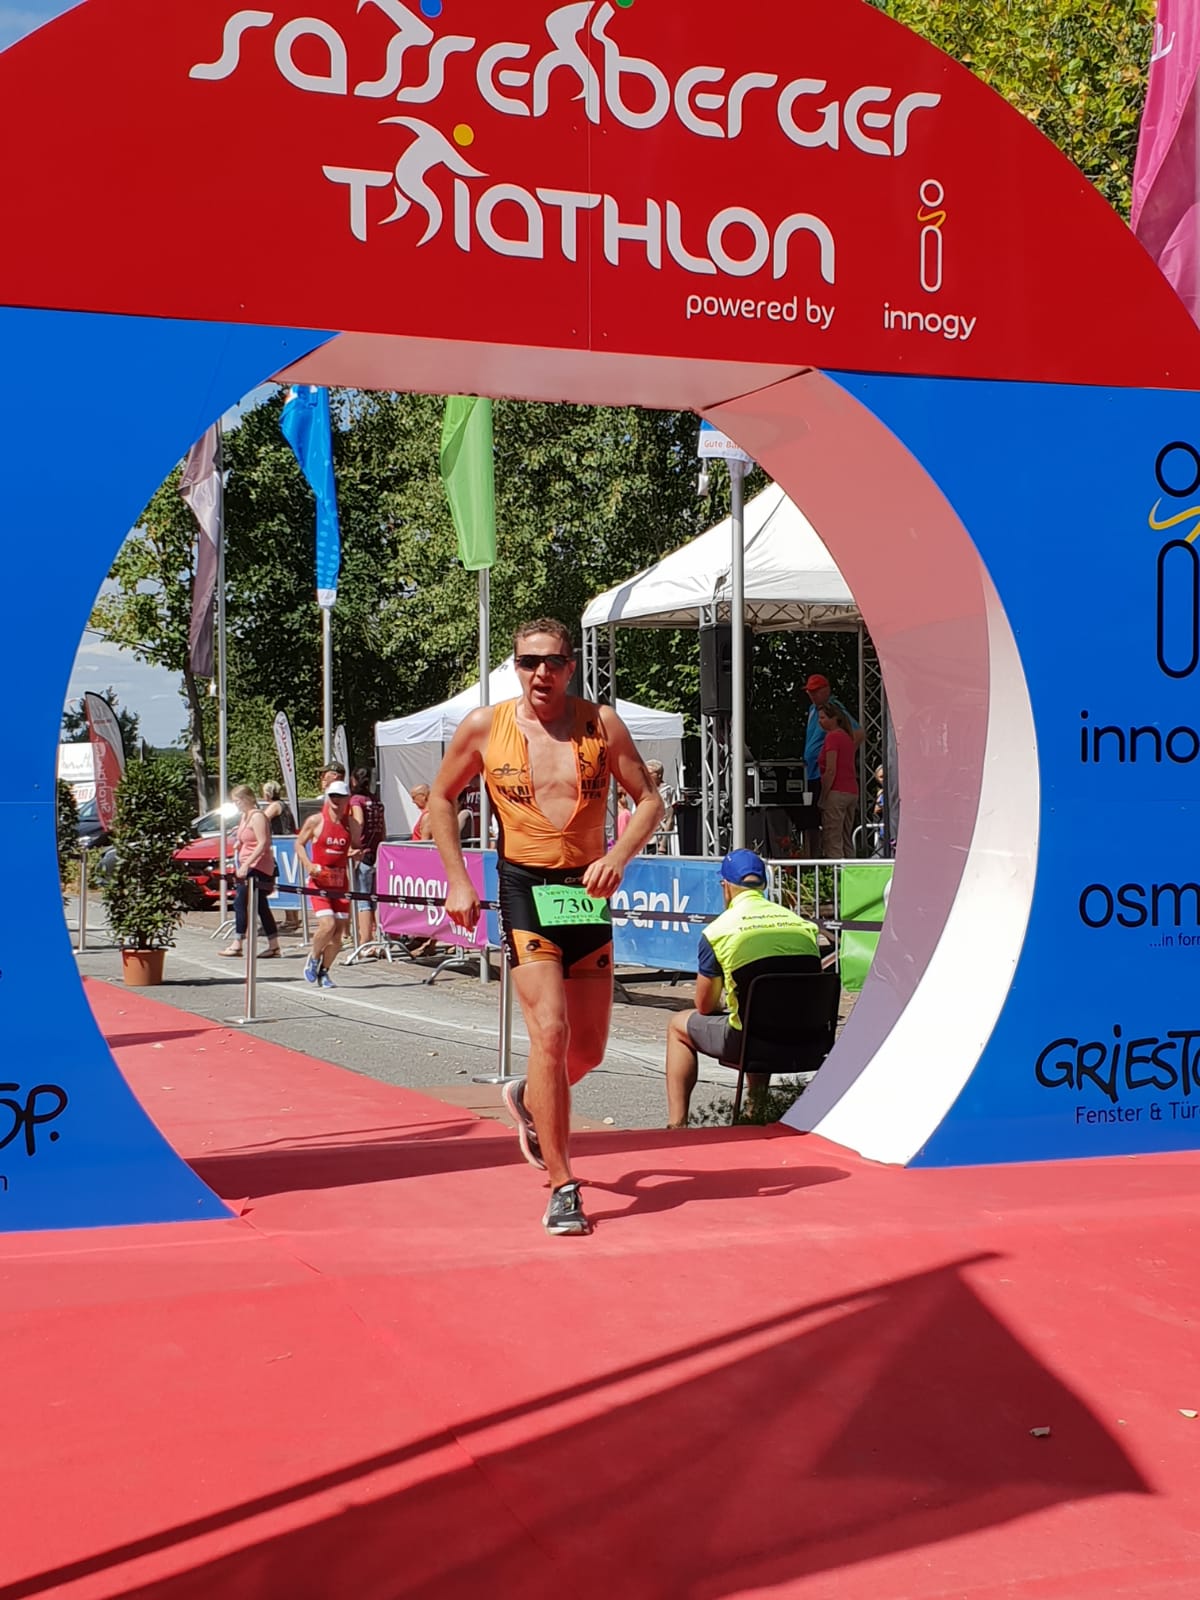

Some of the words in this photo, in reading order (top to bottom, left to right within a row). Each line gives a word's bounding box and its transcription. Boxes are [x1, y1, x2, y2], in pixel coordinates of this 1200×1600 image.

[686, 294, 798, 322] powered
[806, 296, 835, 329] by
[883, 302, 977, 340] innogy
[704, 439, 723, 448] Gute
[553, 897, 594, 914] 730
[1076, 1105, 1143, 1124] Fenster
[1149, 1102, 1162, 1120] &
